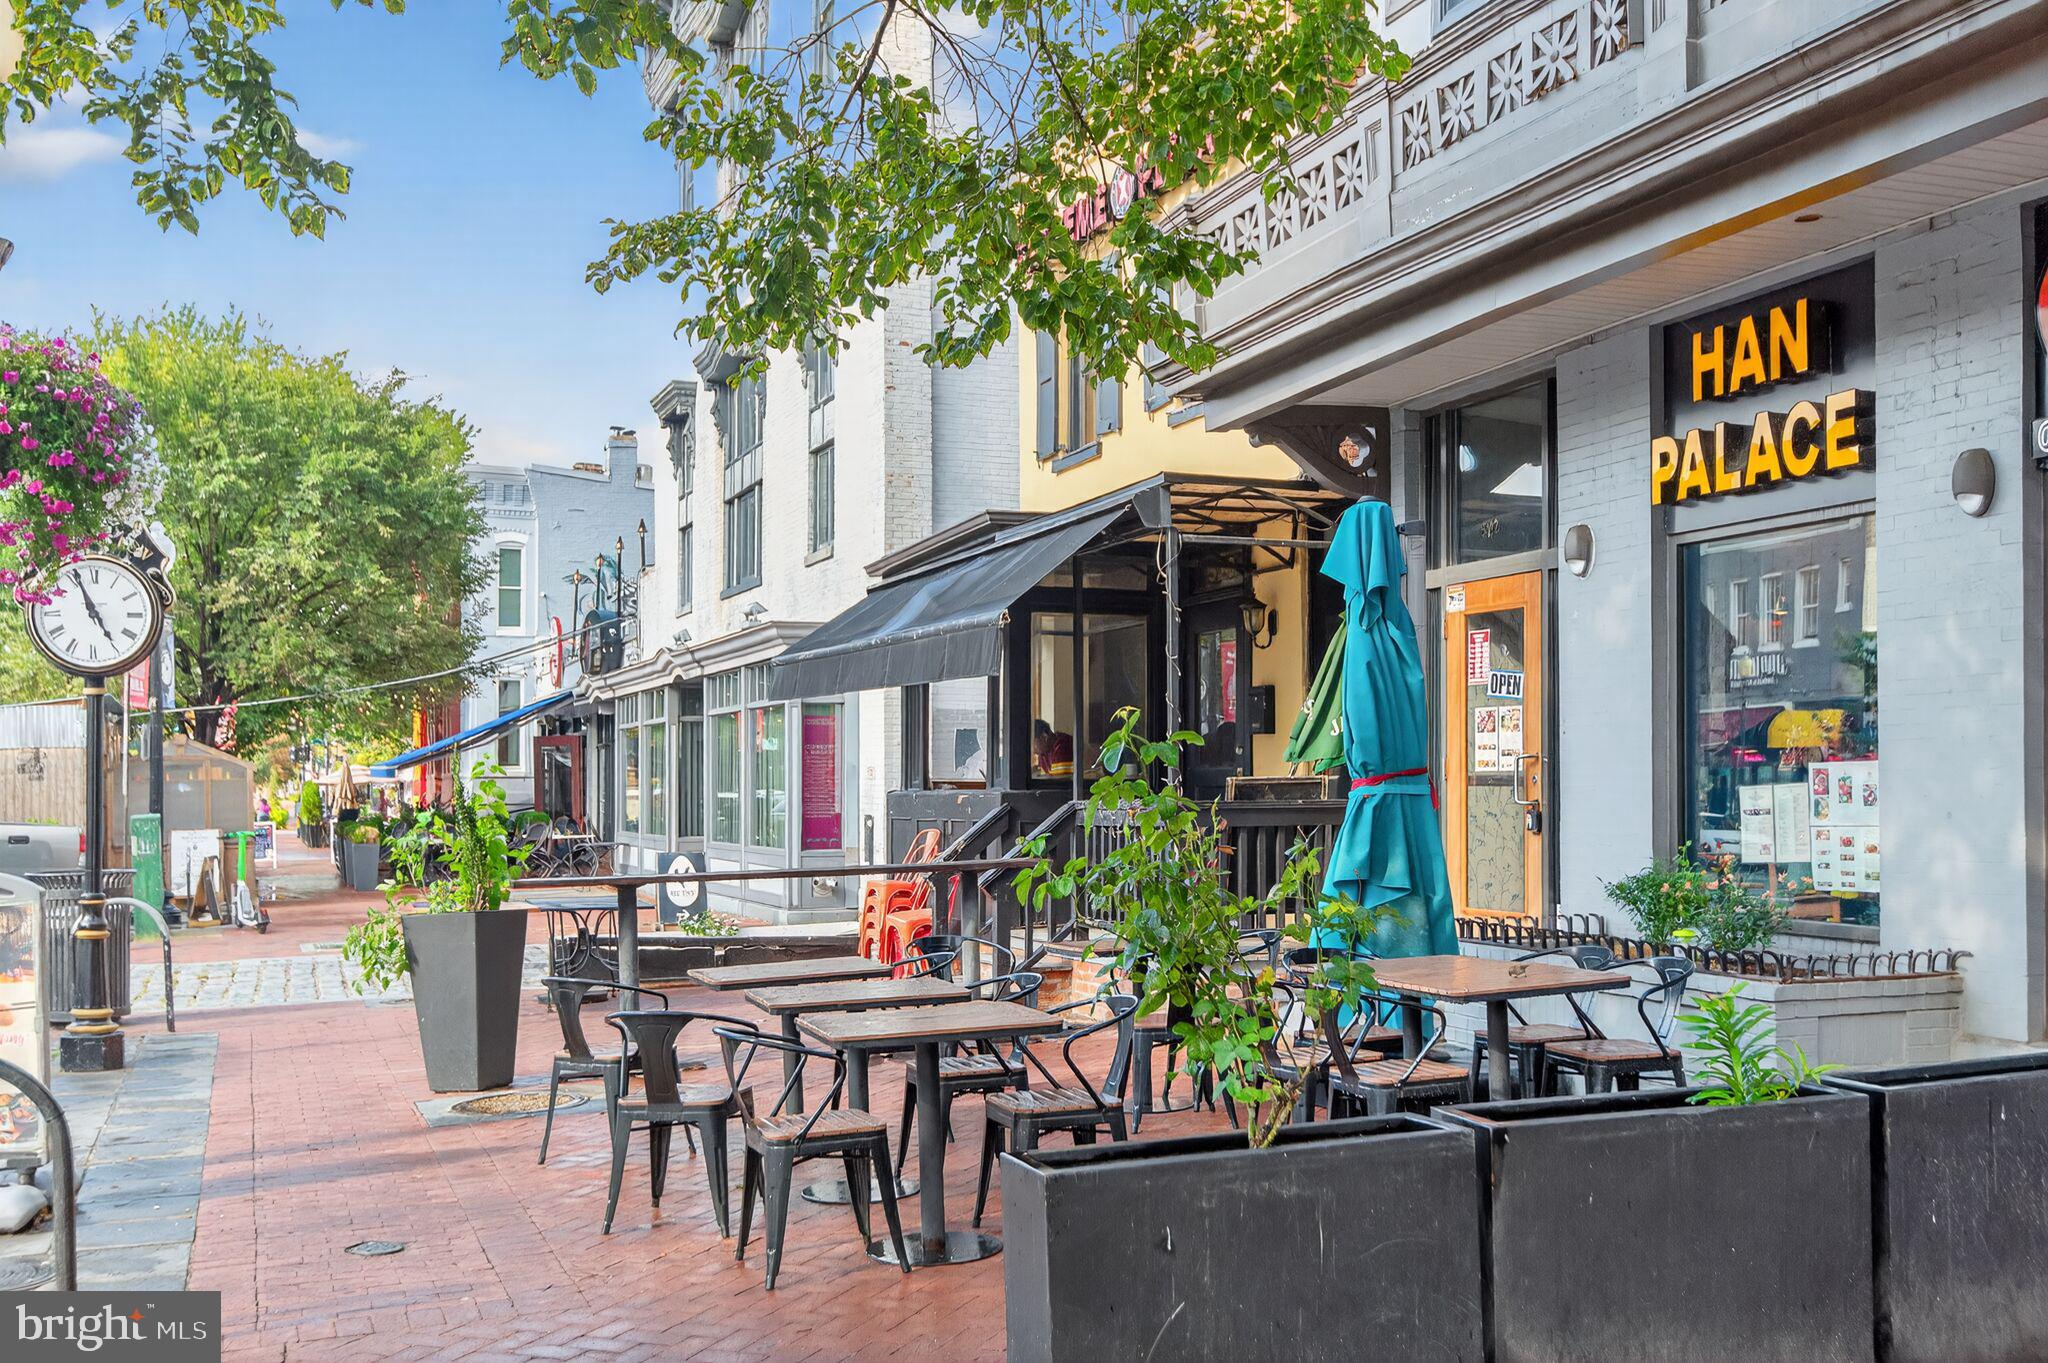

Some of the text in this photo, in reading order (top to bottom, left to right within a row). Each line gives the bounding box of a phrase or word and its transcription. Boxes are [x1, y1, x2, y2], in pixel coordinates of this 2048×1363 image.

[1692, 297, 1808, 403] HAN
[1651, 388, 1860, 506] PALACE
[1490, 673, 1521, 696] OPEN
